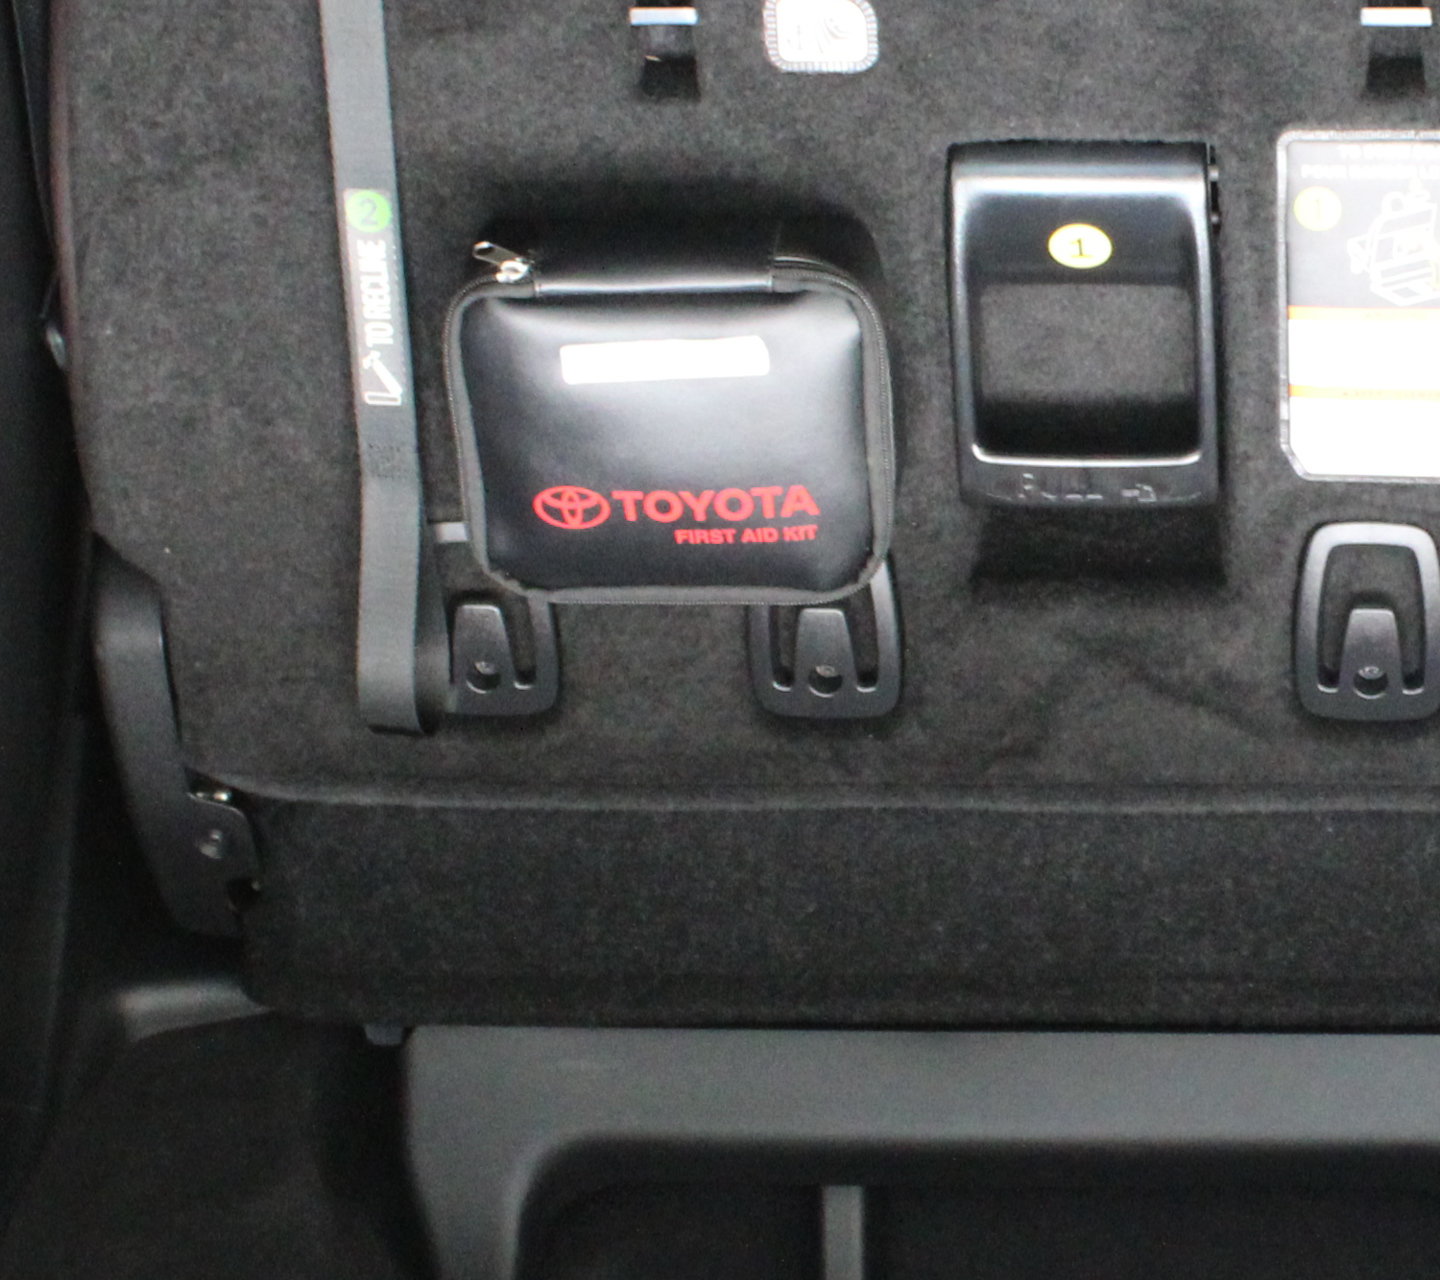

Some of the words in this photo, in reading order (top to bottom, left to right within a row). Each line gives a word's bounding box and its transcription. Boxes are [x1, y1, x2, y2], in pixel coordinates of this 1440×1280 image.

[1071, 238, 1091, 258] 1
[357, 240, 392, 320] RECLINE
[364, 322, 393, 347] TO
[611, 485, 820, 522] TOYOTA
[673, 527, 738, 545] FIRST
[740, 527, 781, 544] AID
[782, 524, 819, 542] KIT
